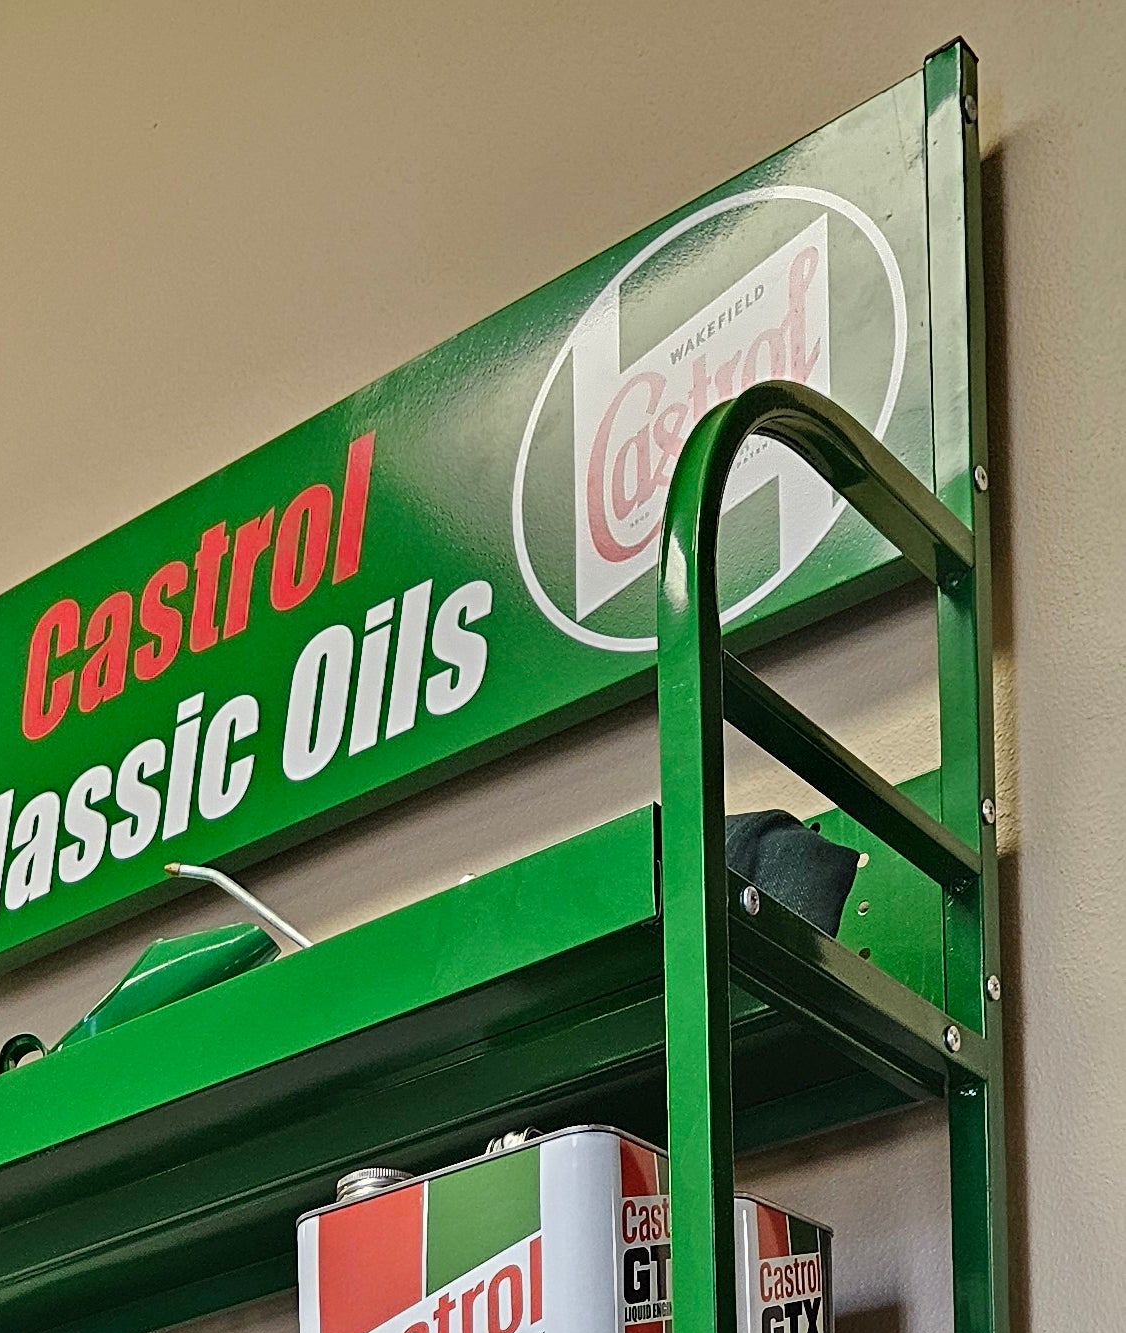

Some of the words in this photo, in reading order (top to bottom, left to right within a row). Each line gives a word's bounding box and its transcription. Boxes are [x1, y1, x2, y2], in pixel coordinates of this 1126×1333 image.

[670, 284, 765, 365] WAKEFIELD
[21, 430, 375, 740] Castrol
[281, 579, 493, 782] Oils
[622, 1198, 671, 1244] Cast
[624, 1244, 671, 1304] GT
[760, 1254, 821, 1303] Castrol
[625, 1303, 651, 1322] LIQUID
